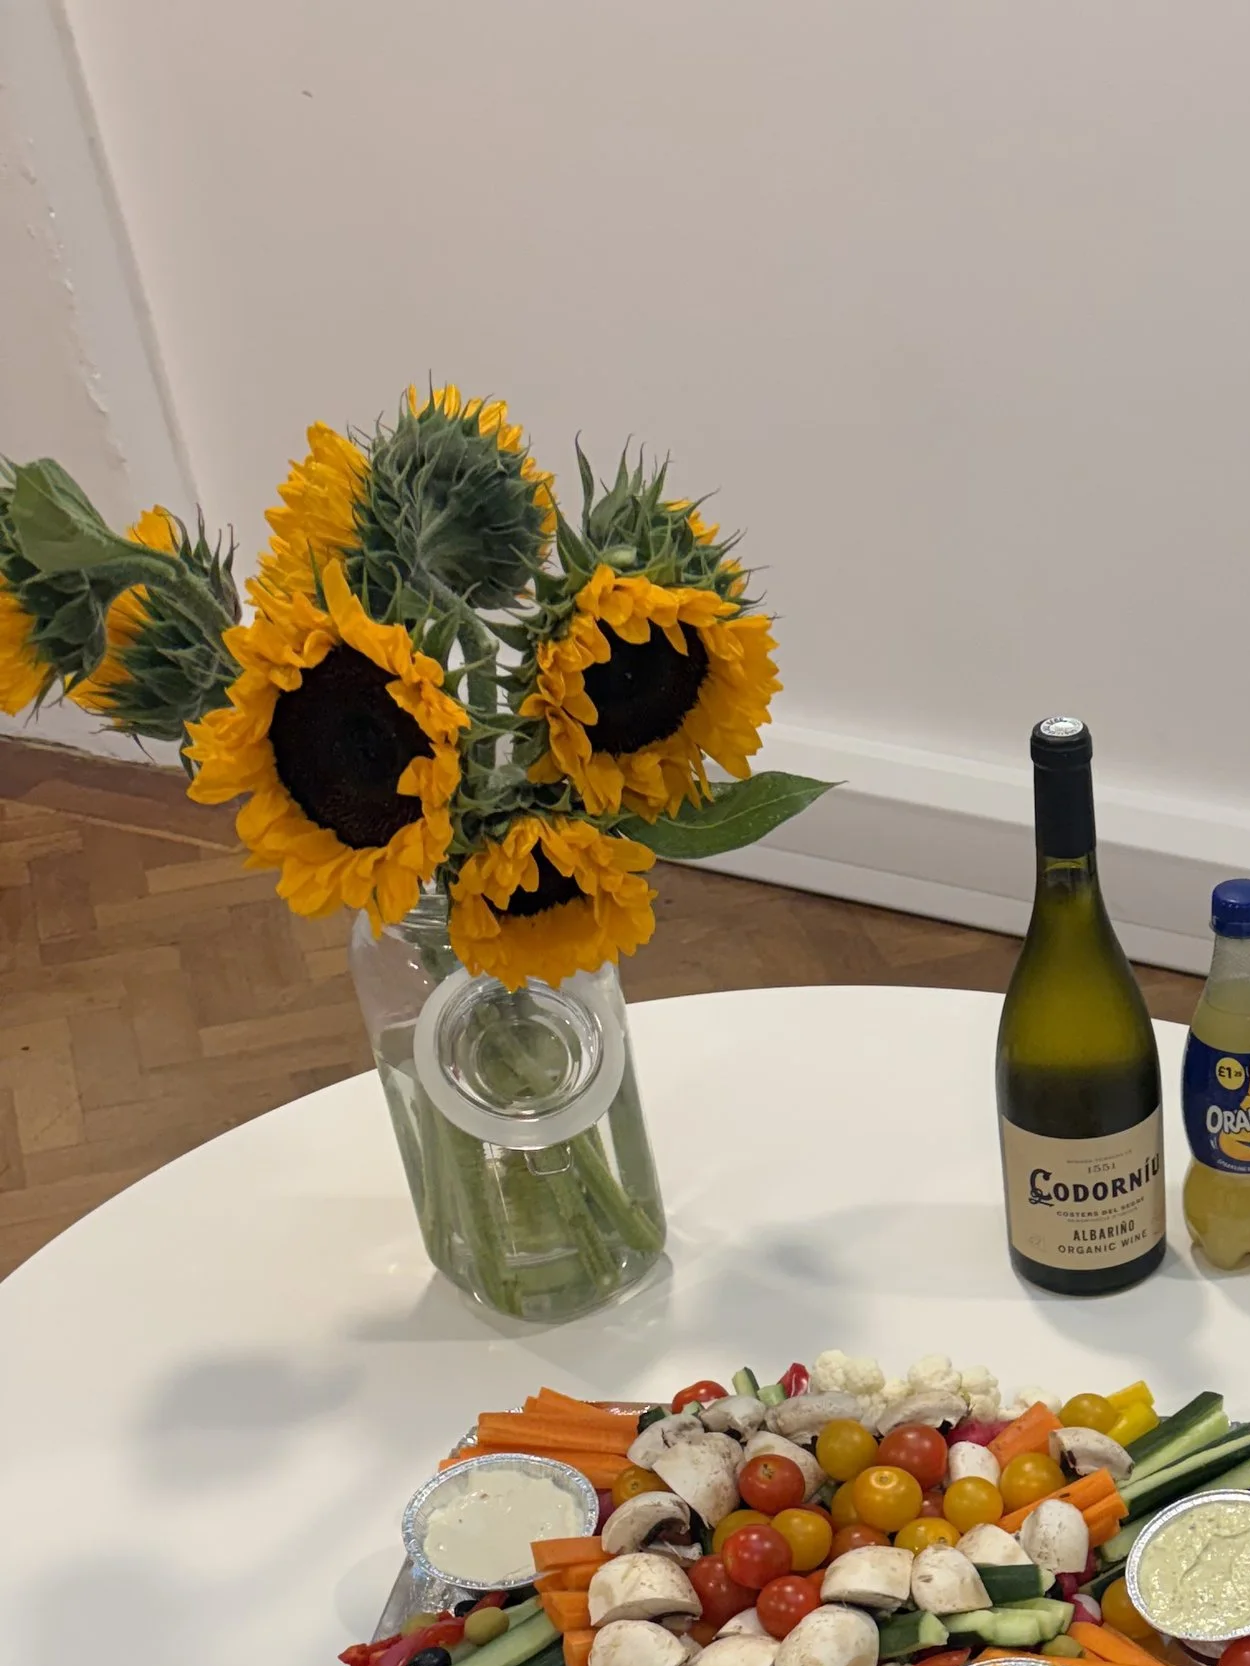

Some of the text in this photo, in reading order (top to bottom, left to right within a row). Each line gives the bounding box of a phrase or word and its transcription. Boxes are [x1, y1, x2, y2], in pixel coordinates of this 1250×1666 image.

[1028, 1153, 1160, 1207] CODORNÍU
[1087, 1162, 1117, 1175] 1551
[1056, 1210, 1099, 1219] COSTERS
[1101, 1207, 1119, 1216] DEL
[1058, 1229, 1148, 1255] ORGANIC WINE
[1073, 1219, 1135, 1242] ALBARIÑO
